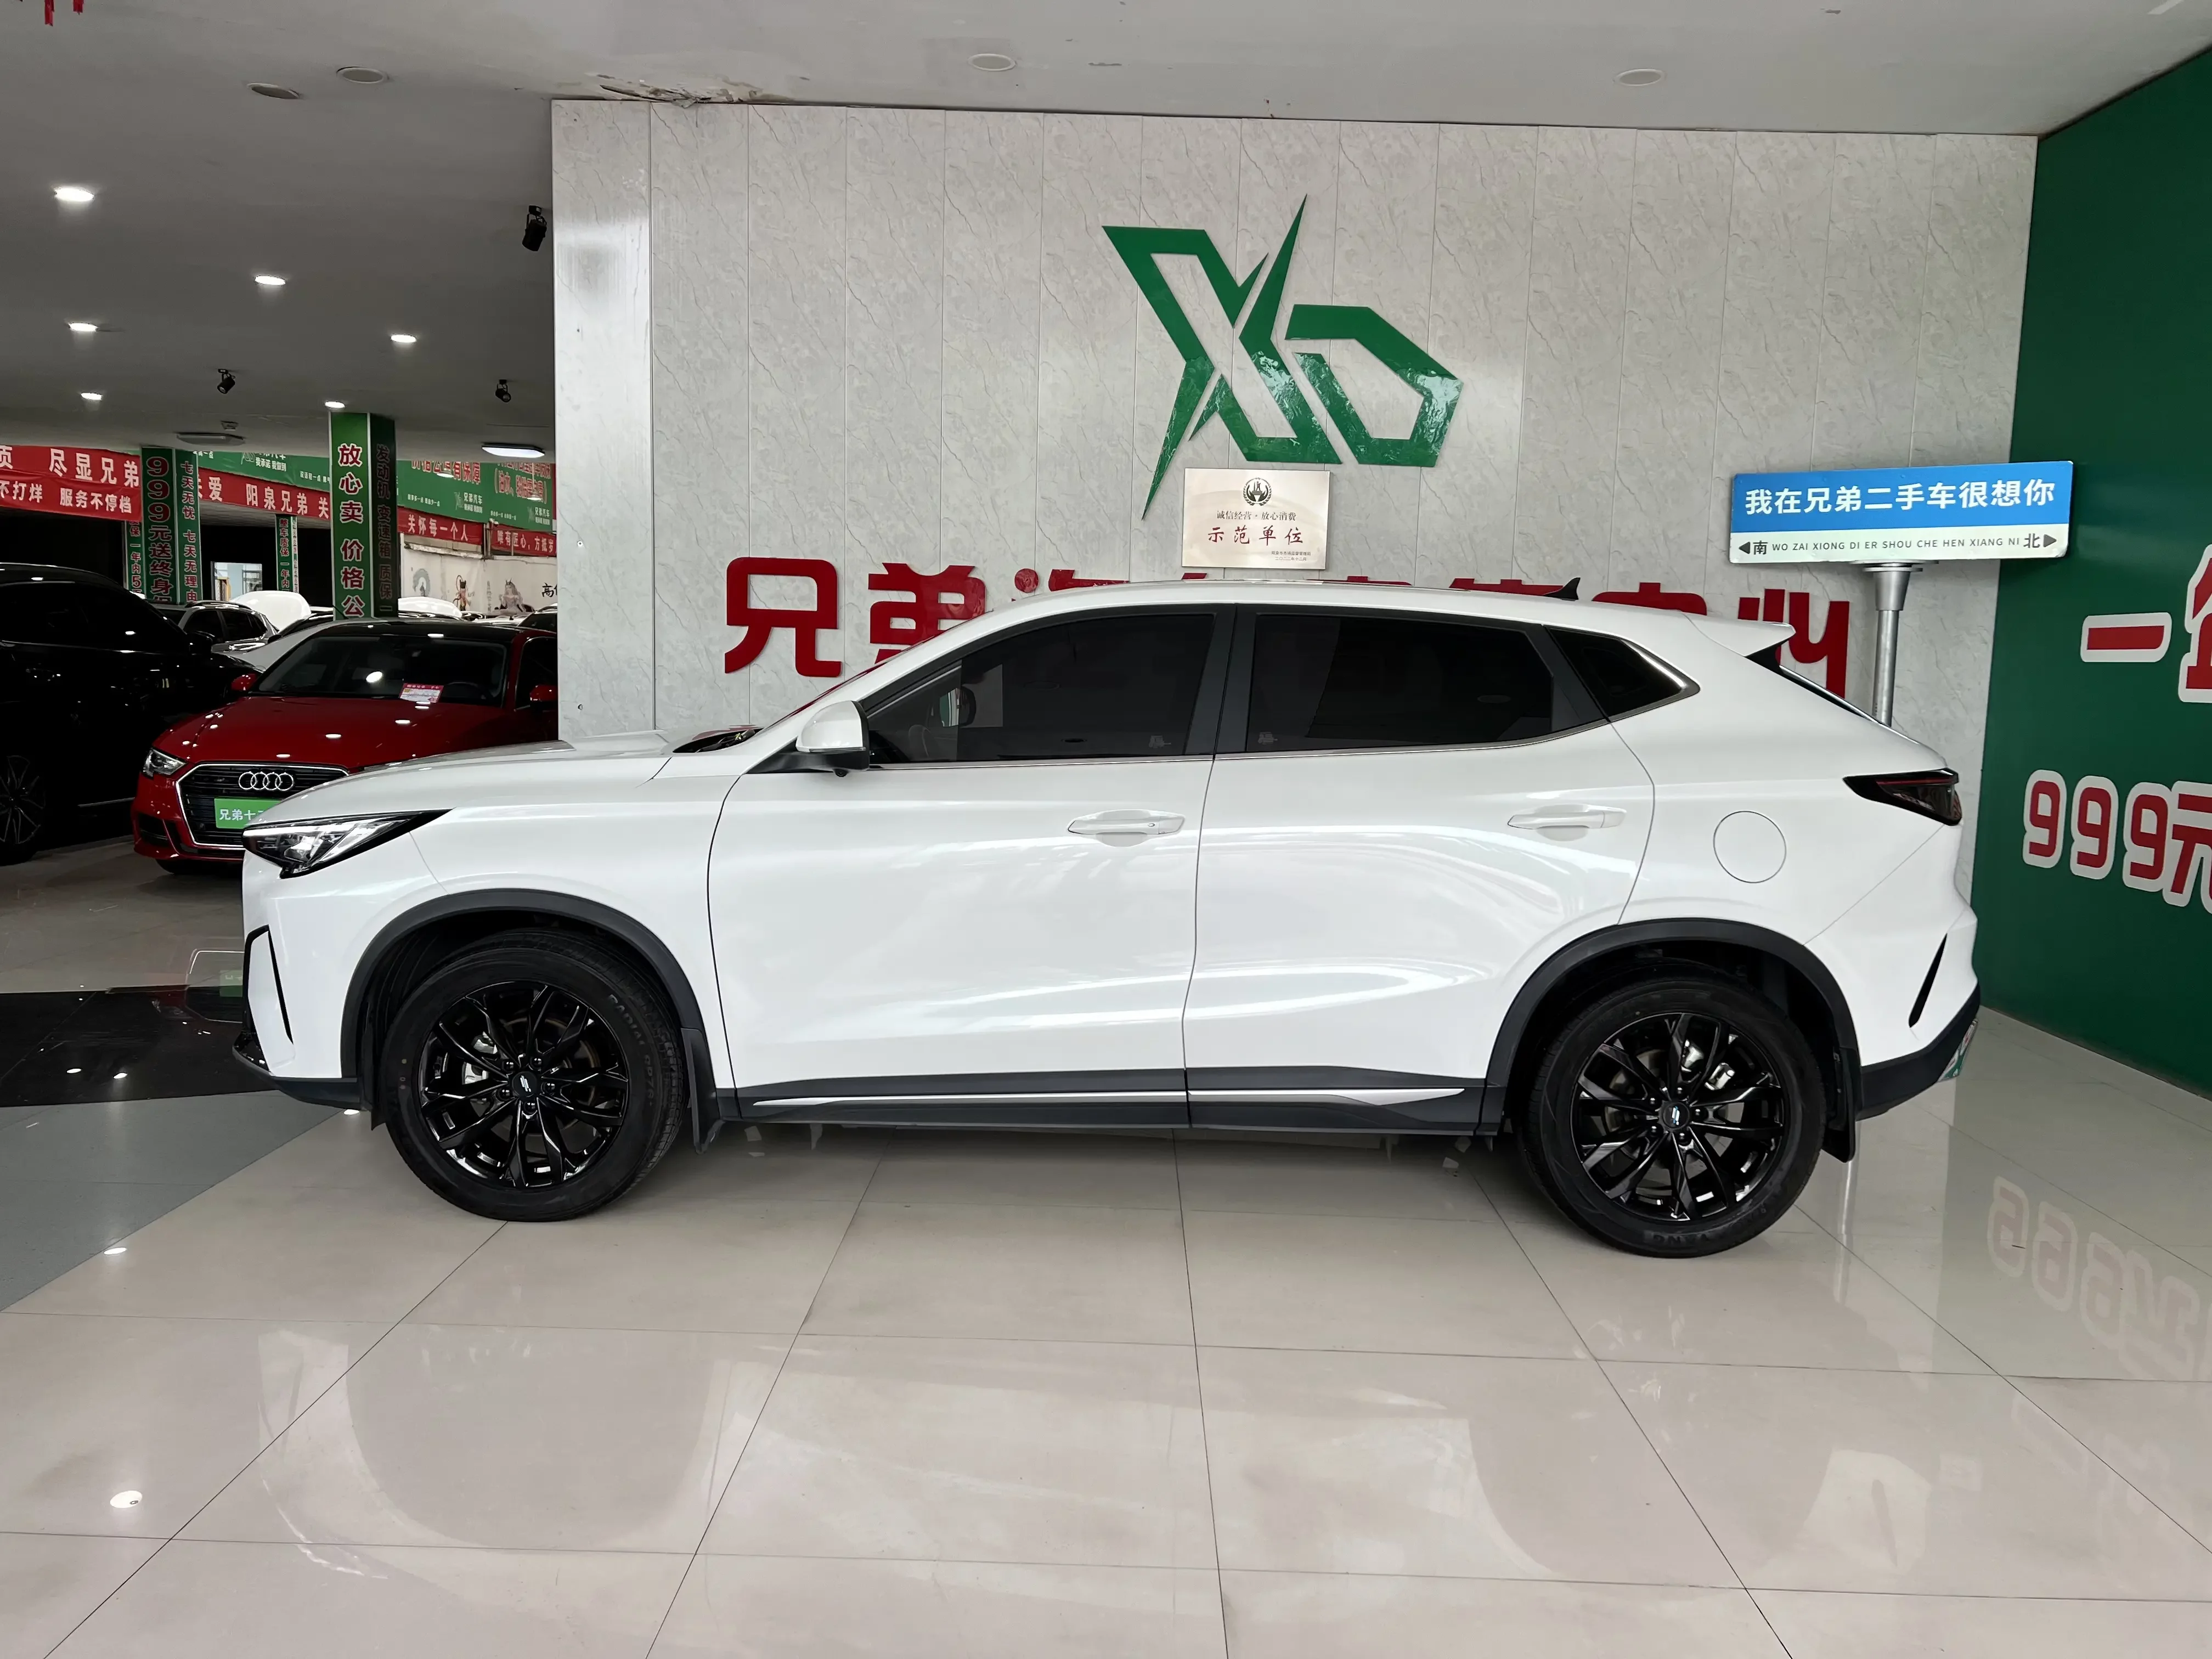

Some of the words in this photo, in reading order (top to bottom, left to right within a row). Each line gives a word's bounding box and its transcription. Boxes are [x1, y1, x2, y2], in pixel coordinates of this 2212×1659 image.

[49, 448, 139, 488] 尽显兄弟
[337, 443, 363, 524] 放心卖
[0, 479, 43, 503] 不打烊
[60, 487, 132, 514] 服务不停档
[180, 460, 195, 520] 七天无忧
[246, 483, 308, 515] 阳泉兄弟
[1745, 479, 2055, 515] 我在兄弟二手车很想你
[129, 520, 141, 537] 保
[408, 514, 468, 541] 关怀每一个人
[1207, 524, 1304, 546] 示范单位
[1753, 540, 1768, 555] 南
[1772, 543, 1788, 551] WO
[1792, 543, 1808, 551] ZAI
[1813, 541, 1845, 550] XIONG
[1882, 540, 1912, 549] SHOU
[1943, 539, 1965, 547] HEN
[1970, 538, 2003, 546] XIANG
[2008, 537, 2019, 545] NI
[2023, 533, 2040, 549] 北
[183, 529, 198, 602] 七天无理由
[340, 538, 366, 618] 价格公
[541, 582, 558, 597] 高
[219, 809, 264, 821] 兄弟十
